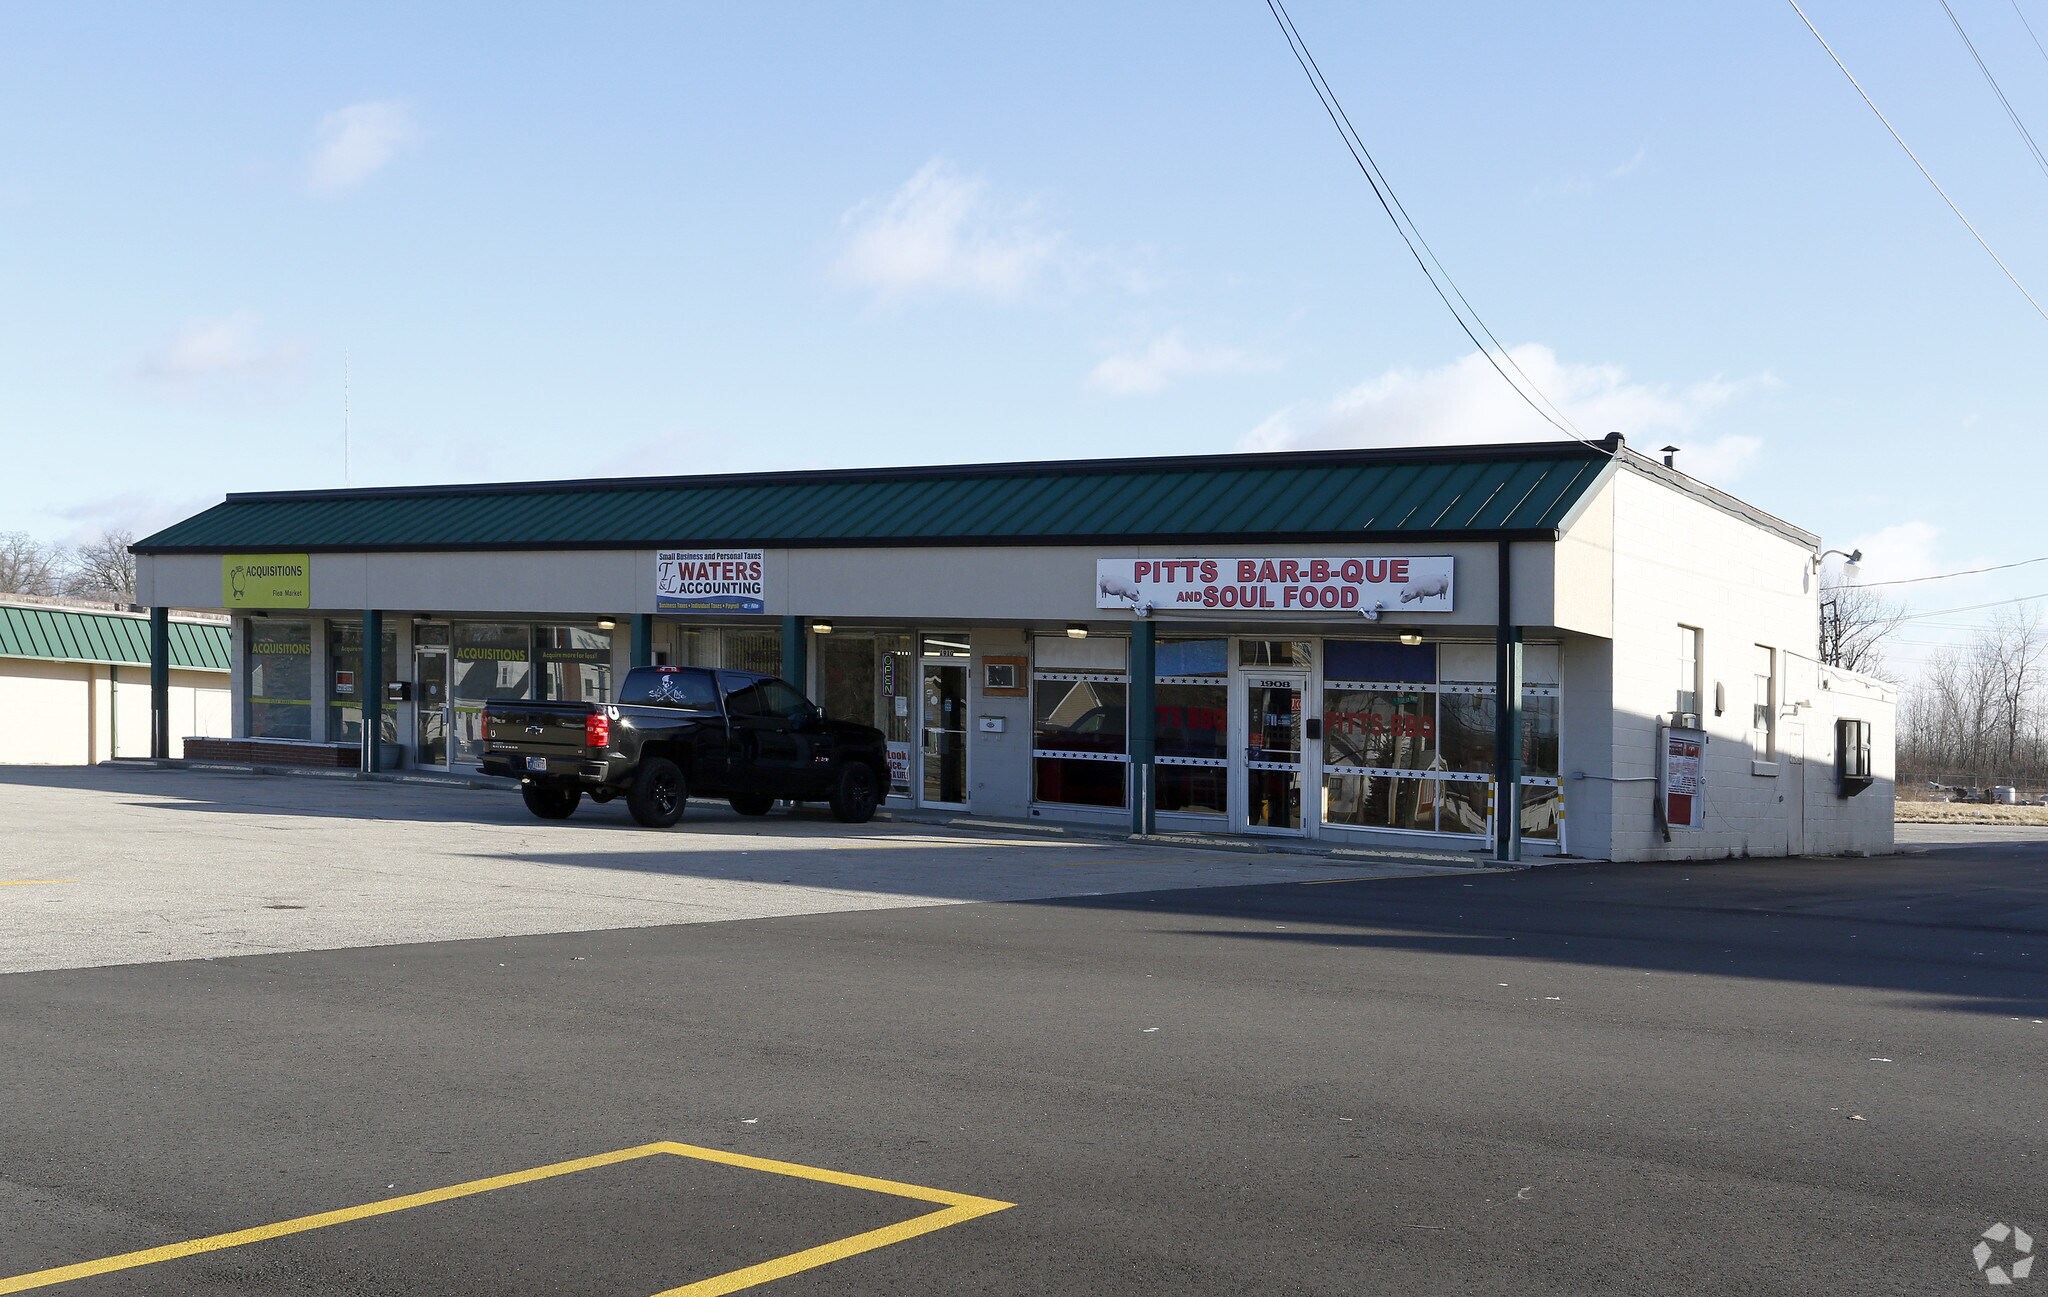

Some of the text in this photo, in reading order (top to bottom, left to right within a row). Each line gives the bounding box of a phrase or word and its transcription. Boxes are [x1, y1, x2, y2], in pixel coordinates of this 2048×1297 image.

[744, 552, 762, 560] Taxes
[246, 566, 303, 578] ACQUISITIONS
[678, 561, 762, 581] WATERS
[1134, 559, 1409, 584] PITTS BAR-B-QUE
[272, 589, 302, 597] Flea Market
[678, 582, 761, 594] ACCOUNTING
[1176, 586, 1359, 608] AND SOUL FOOD
[252, 643, 311, 655] ACQUISITIONS
[457, 648, 526, 660] ACQUISITIONS
[542, 651, 561, 659] Acquire
[884, 655, 893, 694] OPEN
[1260, 680, 1290, 688] 1908
[1187, 707, 1226, 731] BBQ
[1324, 710, 1435, 740] PITTS BBQ
